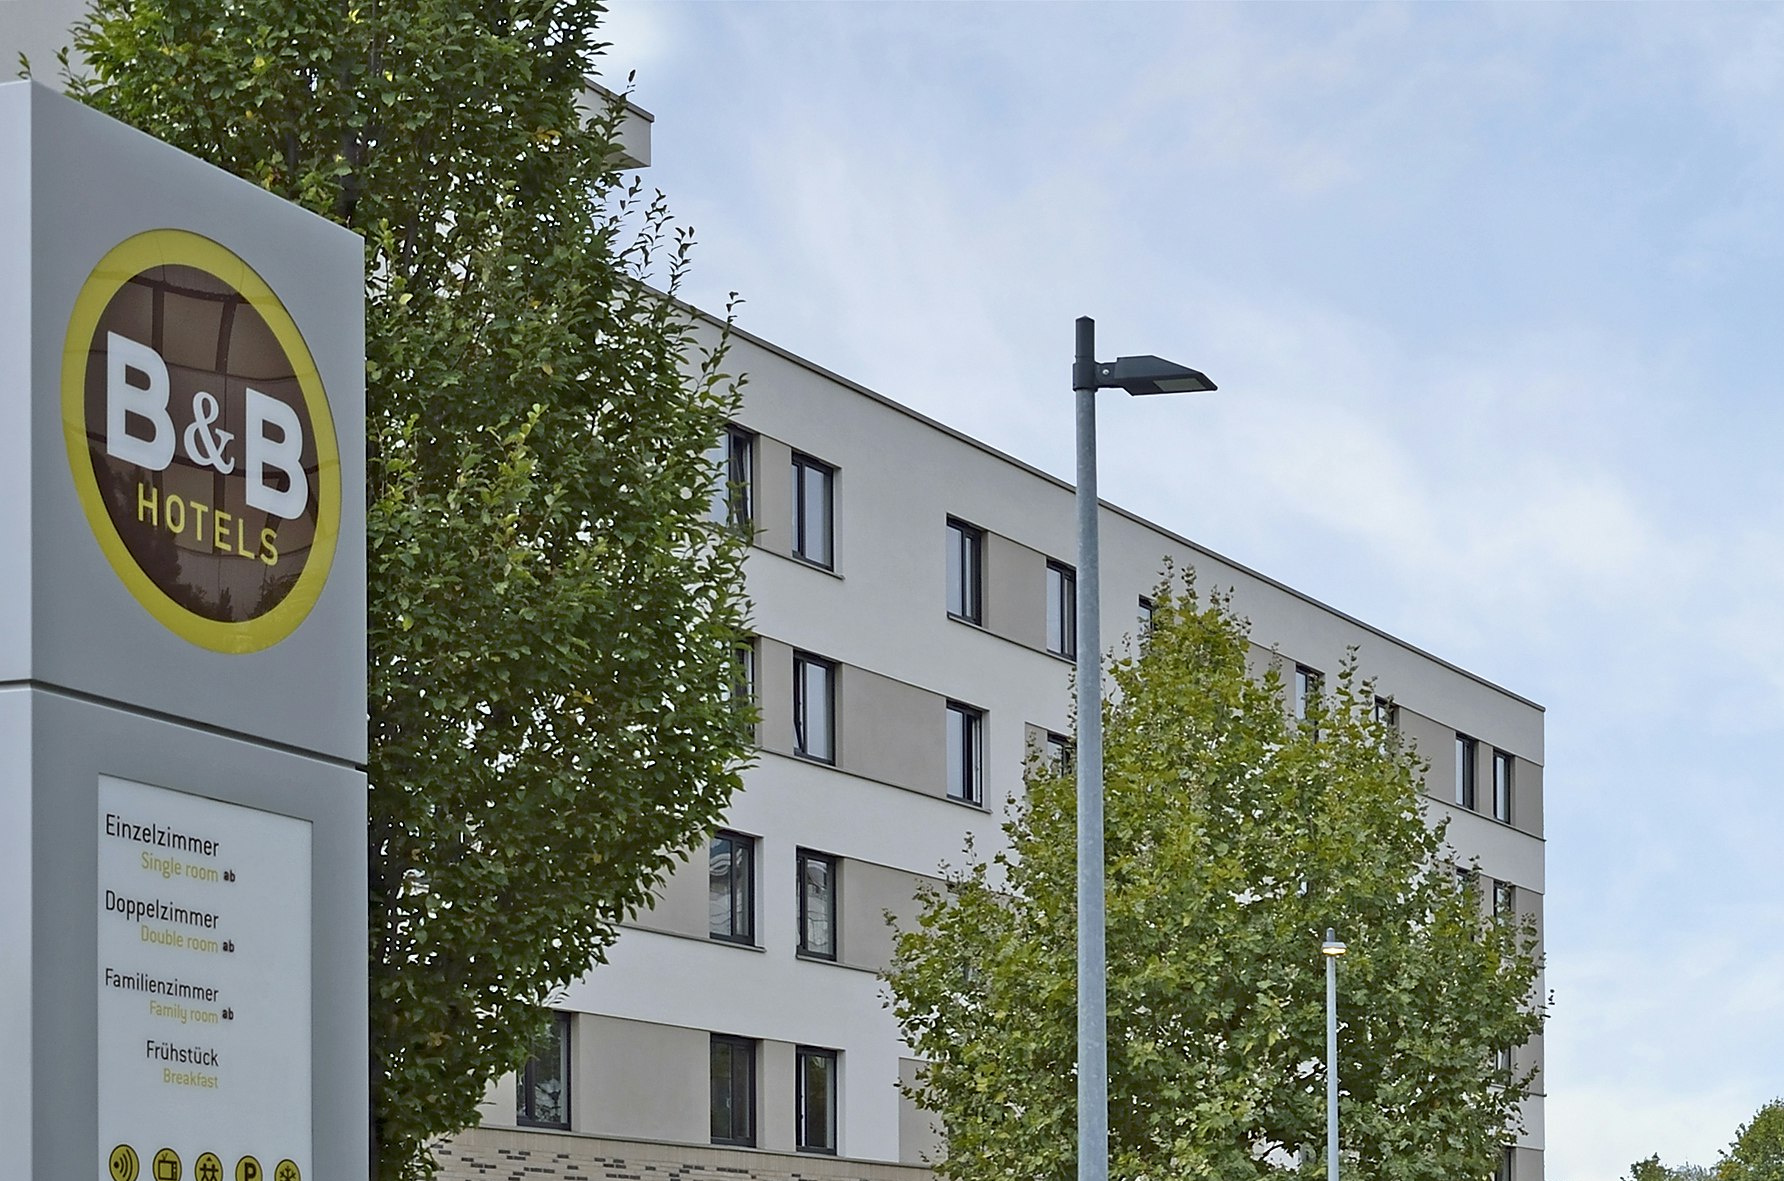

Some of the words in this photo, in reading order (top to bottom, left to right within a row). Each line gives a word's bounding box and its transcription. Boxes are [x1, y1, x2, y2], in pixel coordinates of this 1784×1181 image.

[107, 330, 309, 520] B&B
[137, 482, 279, 567] HOTELS
[105, 812, 219, 857] Einzelzimmer
[141, 851, 182, 879] Single
[185, 863, 219, 882] room
[223, 869, 236, 883] ab
[105, 889, 219, 930] Doppelzimmer
[141, 924, 184, 948] Double
[187, 935, 219, 954] room
[222, 938, 235, 953] ab
[105, 967, 219, 1003] Familienzimmer
[149, 999, 188, 1025] Family
[190, 1009, 219, 1024] room
[222, 1006, 234, 1020] ab
[146, 1039, 219, 1067] Frühstück
[163, 1067, 218, 1089] Breakfast
